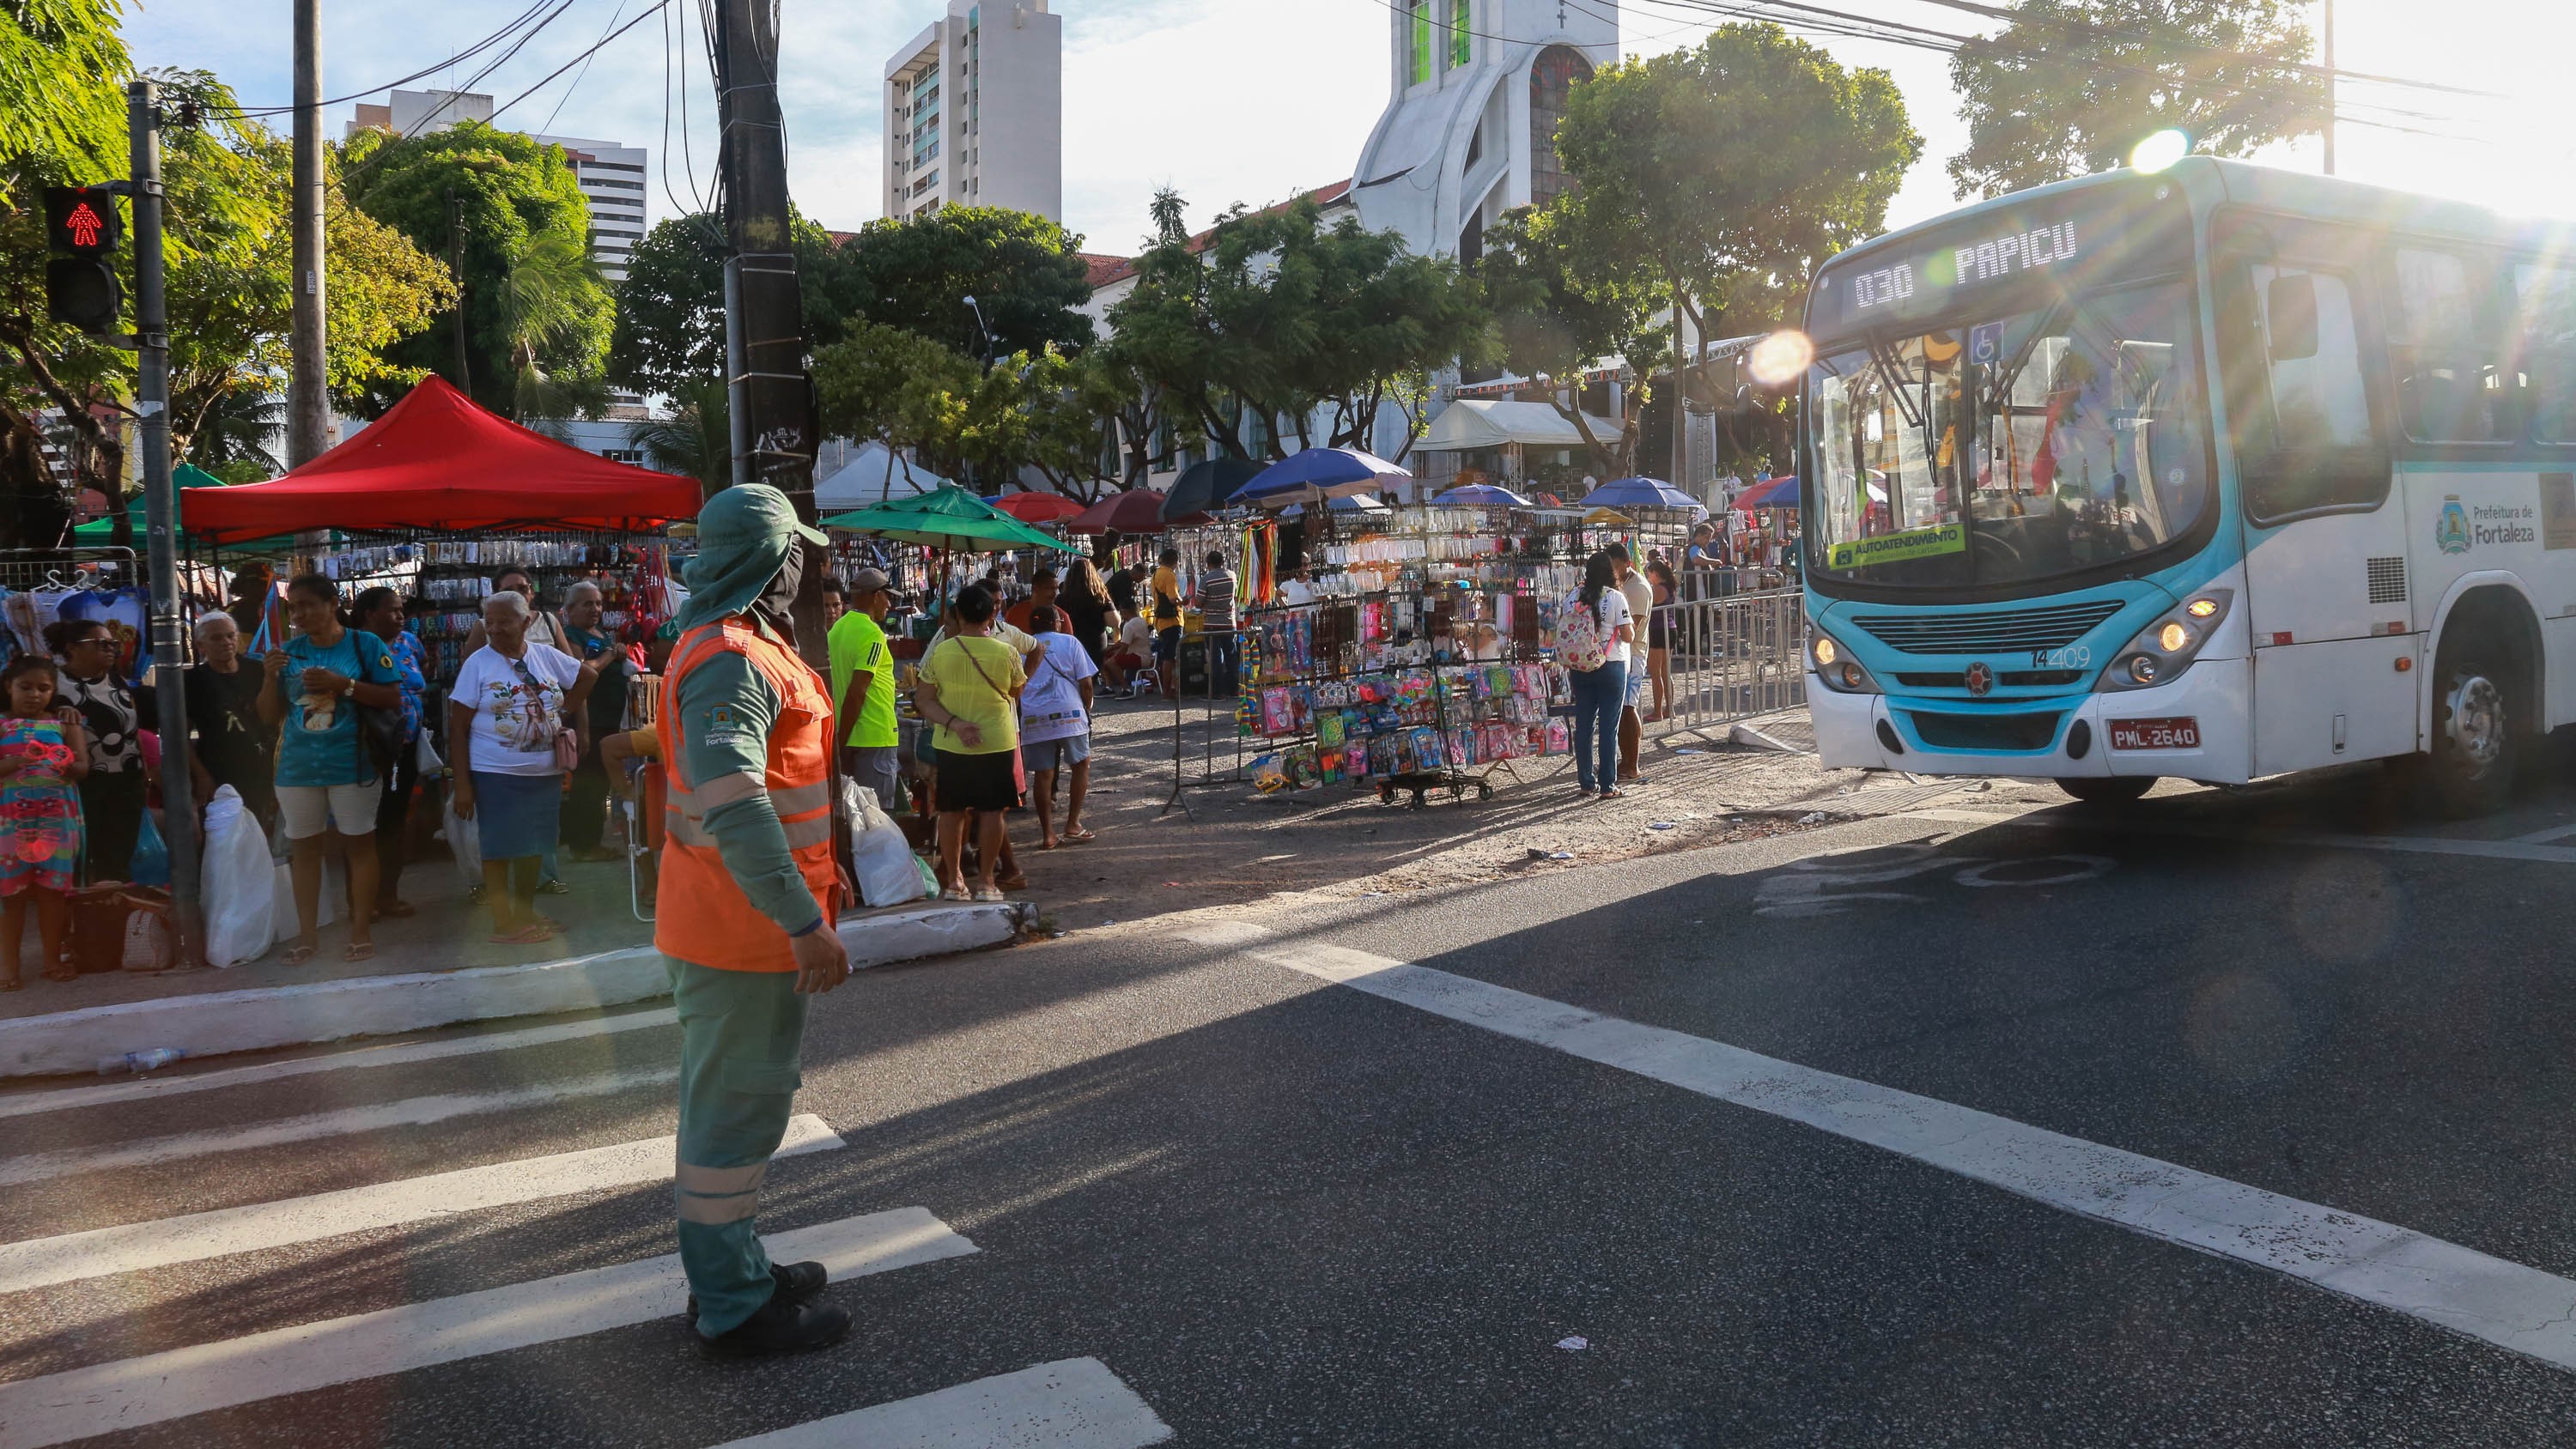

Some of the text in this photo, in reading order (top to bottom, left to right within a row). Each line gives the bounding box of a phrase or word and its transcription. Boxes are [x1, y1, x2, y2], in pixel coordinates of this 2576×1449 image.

[1855, 221, 2077, 308] 030 PAPICU
[2474, 505, 2533, 520] Prefeitura de
[1855, 529, 1958, 555] AUTOATENDIMENTO
[2475, 522, 2534, 545] Fortaleza
